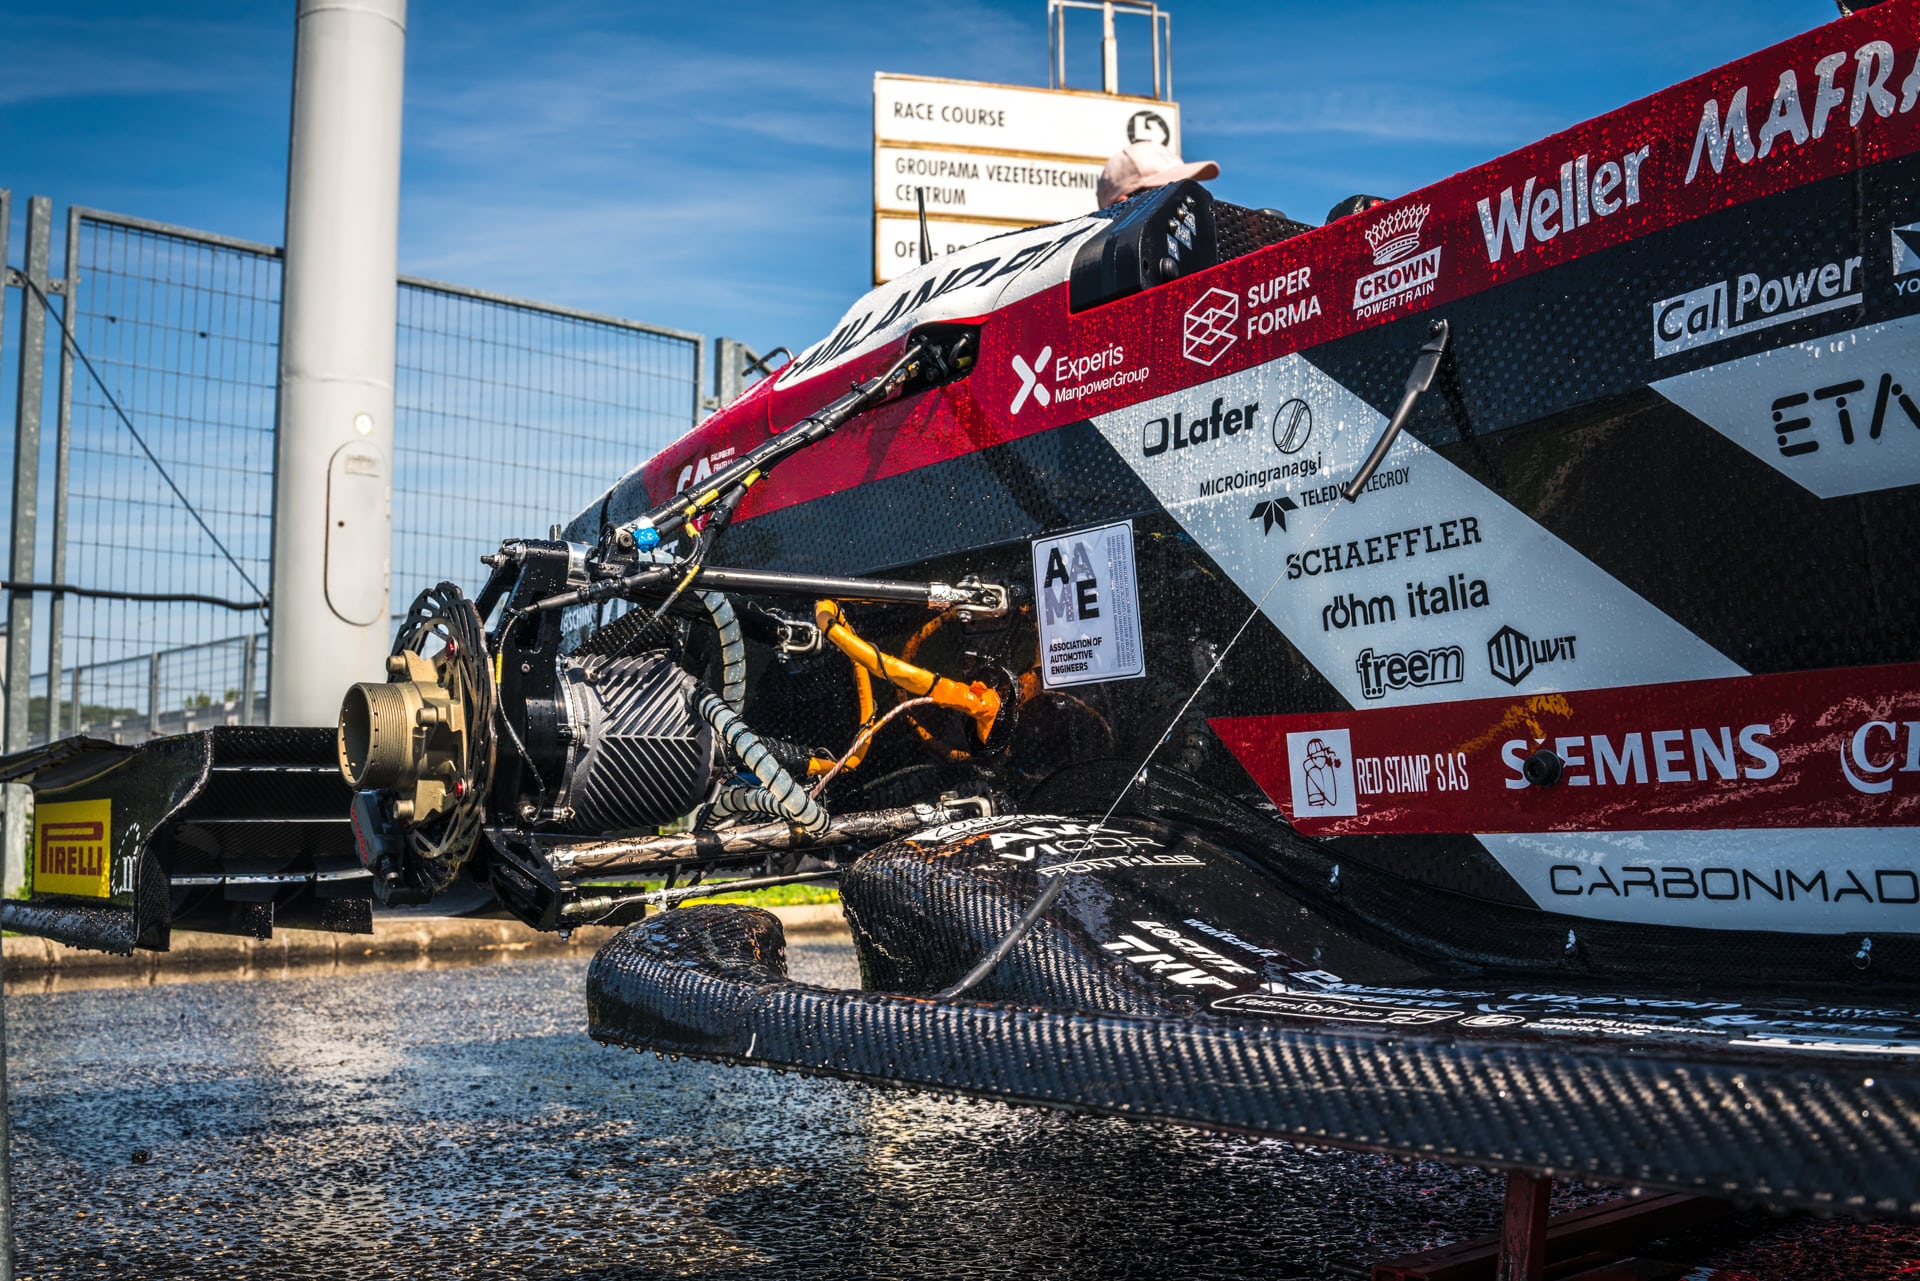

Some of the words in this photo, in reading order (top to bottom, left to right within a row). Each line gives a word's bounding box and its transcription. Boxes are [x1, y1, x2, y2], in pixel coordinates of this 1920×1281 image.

[894, 101, 934, 121] RACE
[941, 105, 1006, 127] COURSE
[896, 157, 979, 180] GROUPAMA
[986, 162, 1099, 189] VEZETÉSTECHNI
[896, 184, 966, 206] CENTRUM
[1477, 145, 1650, 263] Weller
[1247, 266, 1311, 308] SUPER
[1359, 254, 1436, 301] CROWN
[1247, 294, 1322, 340] FORMA
[1056, 342, 1124, 382] Experis
[1055, 367, 1149, 403] ManpowerGroup
[1173, 397, 1259, 450] Lafer
[1200, 451, 1322, 497] MICROingranaggi
[1301, 481, 1363, 507] TELEDY
[1366, 467, 1409, 493] LECROY
[1286, 516, 1482, 581] SCHAEFFLER
[1322, 593, 1396, 632] röhm
[1406, 573, 1490, 618] italia
[1049, 638, 1092, 653] ASSOCIATION
[1092, 636, 1102, 647] OF
[1050, 649, 1093, 664] AUTOMOTIVE
[1050, 661, 1089, 675] ENGINEERS
[1358, 646, 1463, 697] freem
[1355, 757, 1383, 794] RED
[1384, 754, 1431, 793] STAMP
[1501, 724, 1780, 790] SEMENS
[41, 821, 104, 877] PIRELLI
[999, 836, 1166, 862] VICOR
[1549, 863, 1920, 904] CARBONMAD
